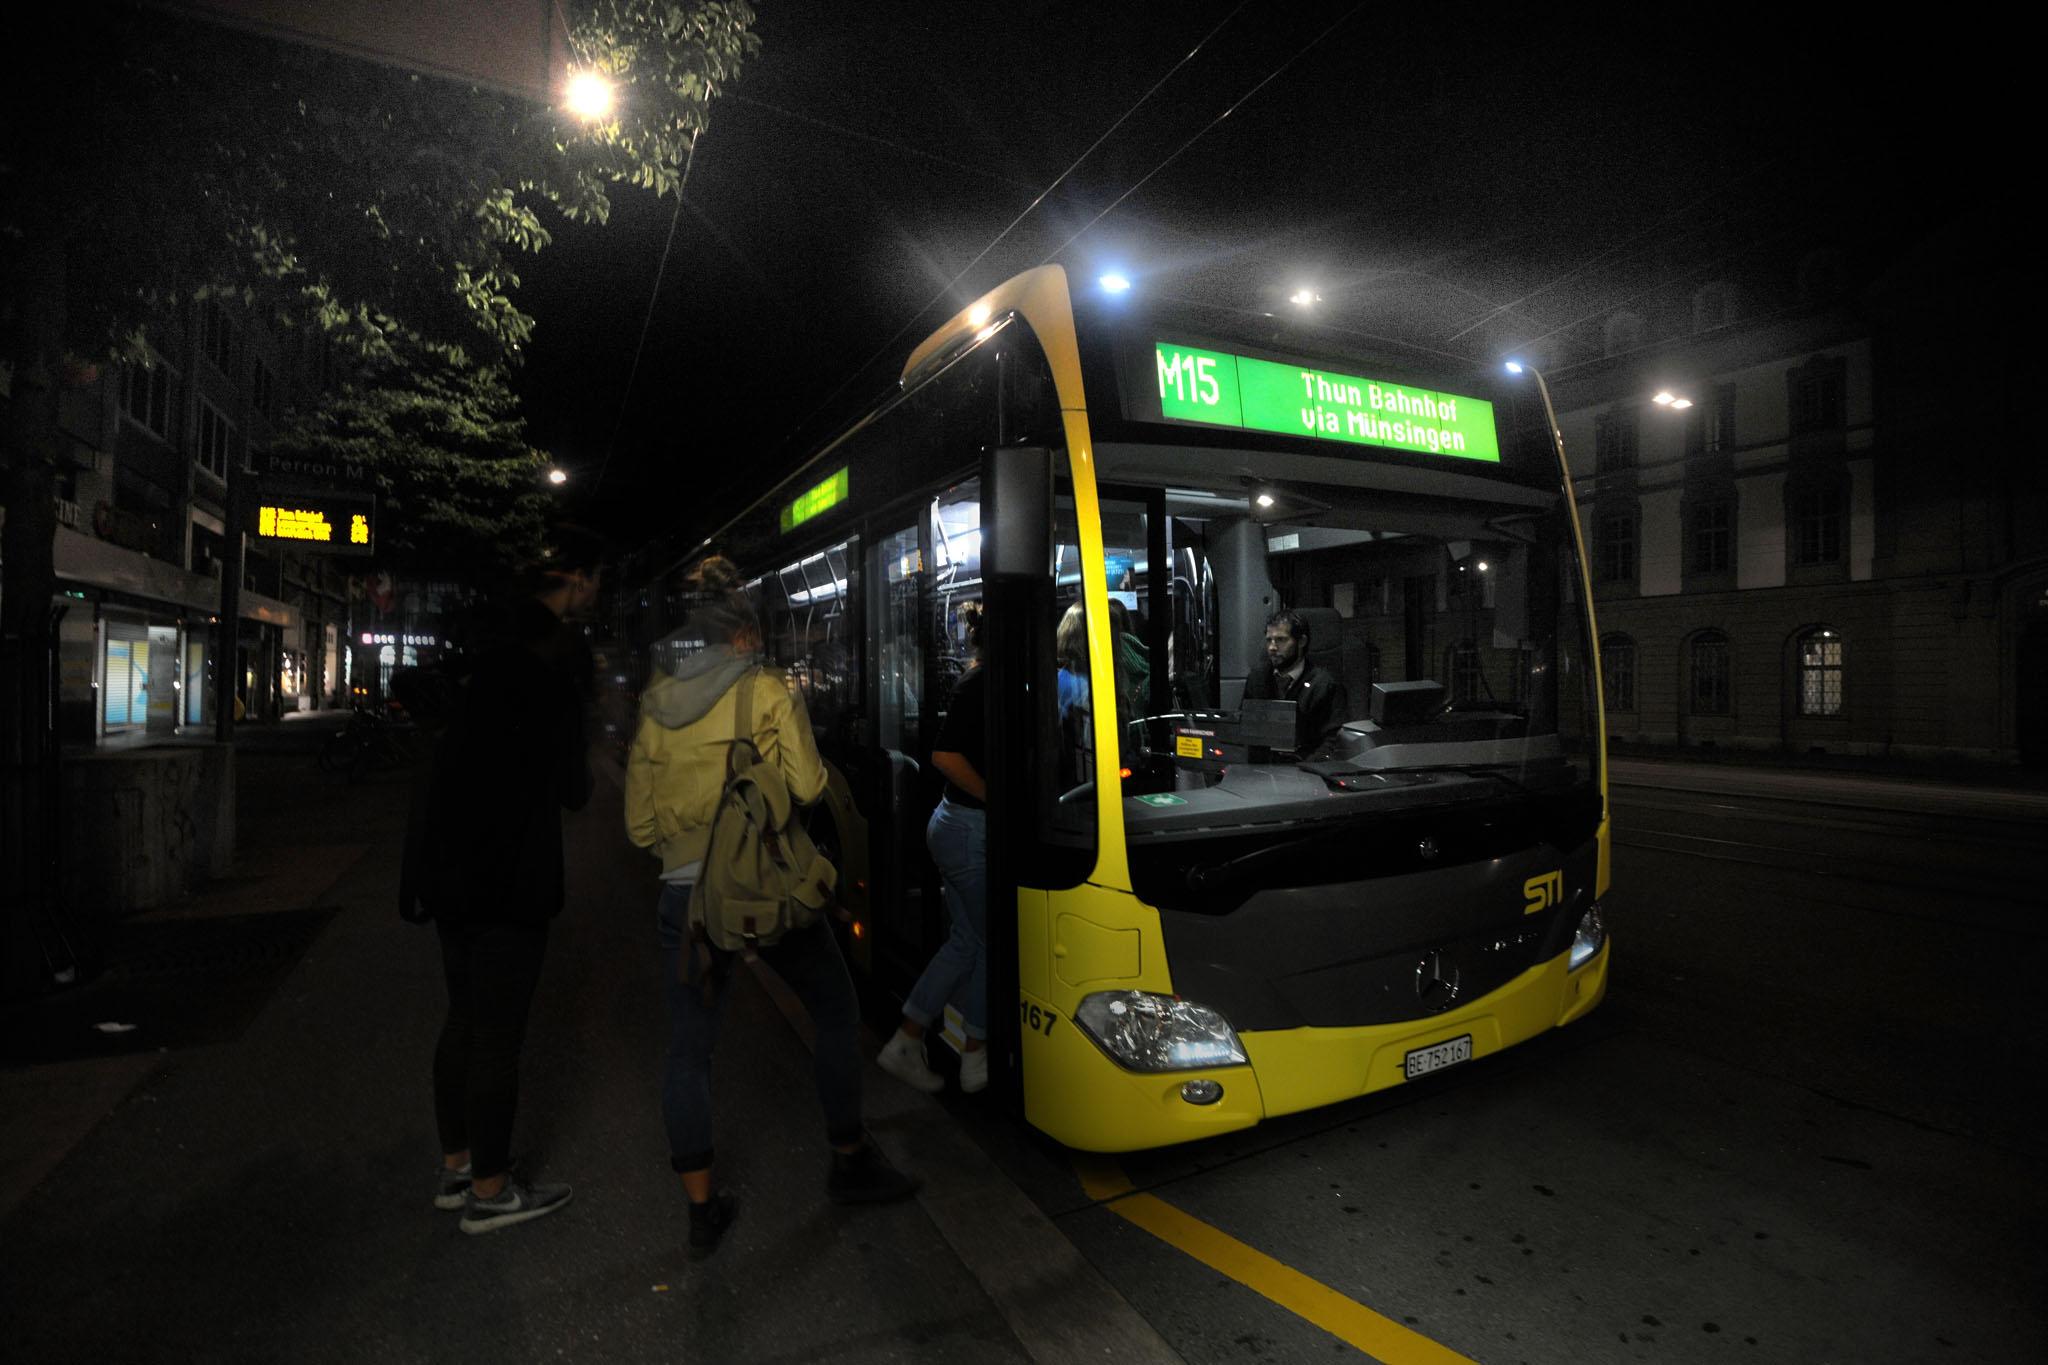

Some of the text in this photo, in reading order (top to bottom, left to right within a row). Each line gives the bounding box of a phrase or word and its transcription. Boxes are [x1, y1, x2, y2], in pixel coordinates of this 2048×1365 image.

[1155, 349, 1458, 422] M15 Thun Bahnhof
[1301, 407, 1466, 453] via Münsingen
[269, 455, 365, 480] Perron M
[1523, 868, 1563, 915] STI
[1020, 1000, 1057, 1037] 167
